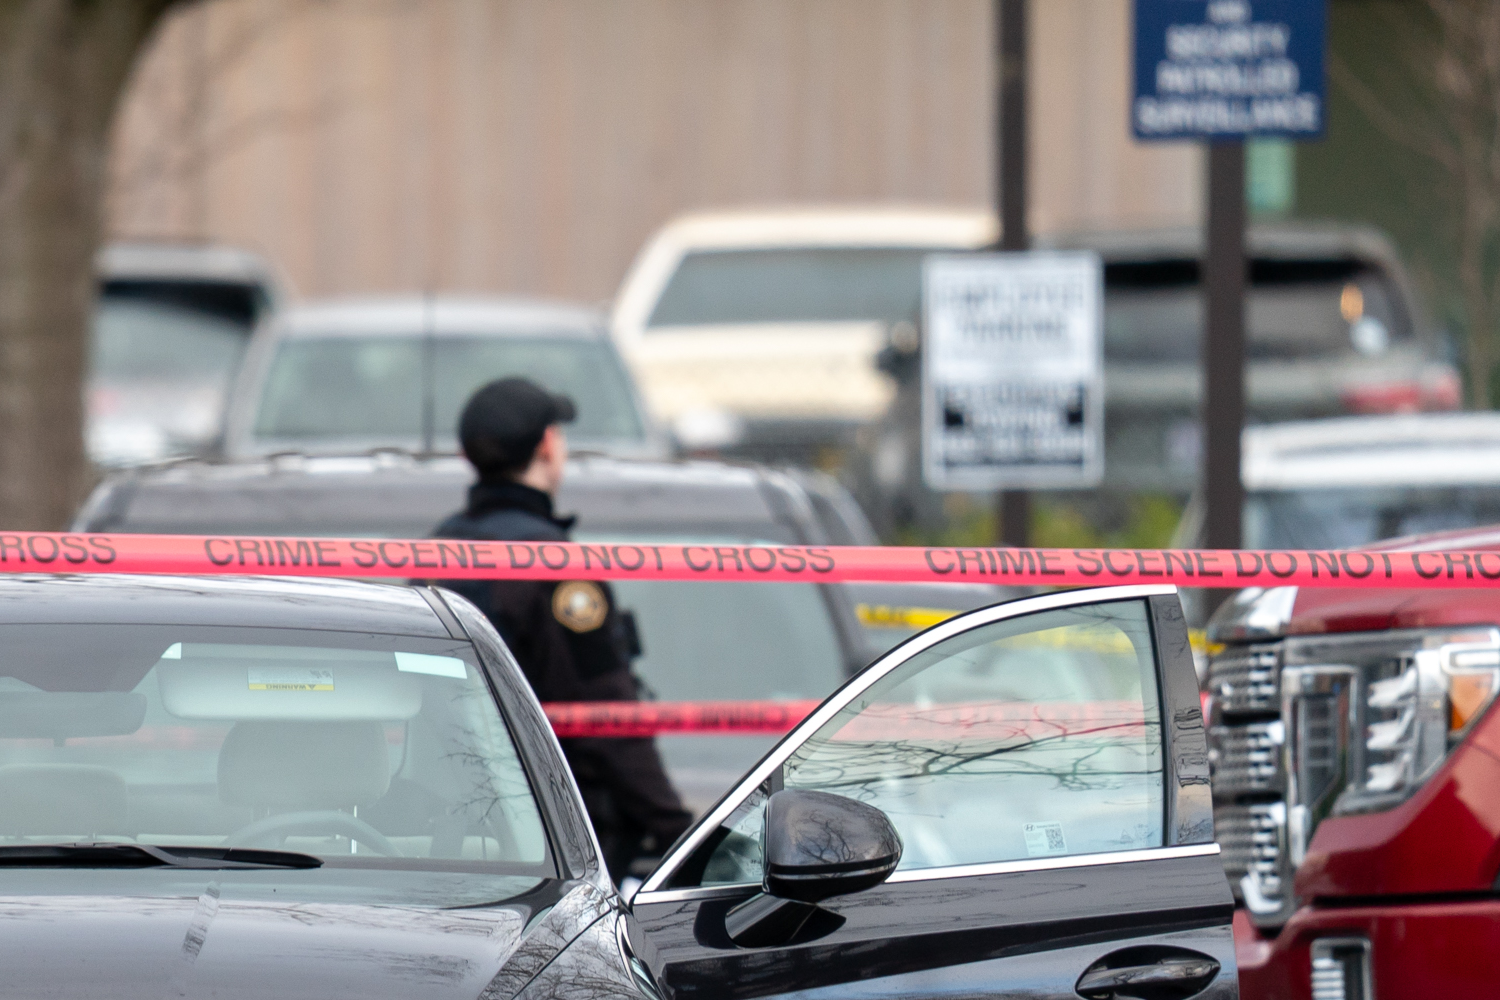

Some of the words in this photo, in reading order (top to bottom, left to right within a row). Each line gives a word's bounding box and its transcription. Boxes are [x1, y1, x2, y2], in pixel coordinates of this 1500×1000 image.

[204, 538, 342, 567] CRIME
[349, 540, 497, 569] SCENE
[509, 544, 572, 571] DO
[582, 545, 666, 572] NOT
[682, 546, 836, 574] CROSS
[923, 549, 1064, 577] CRIME
[1076, 550, 1223, 578] SCENE
[1233, 553, 1299, 578] DO
[1308, 553, 1396, 579] NOT
